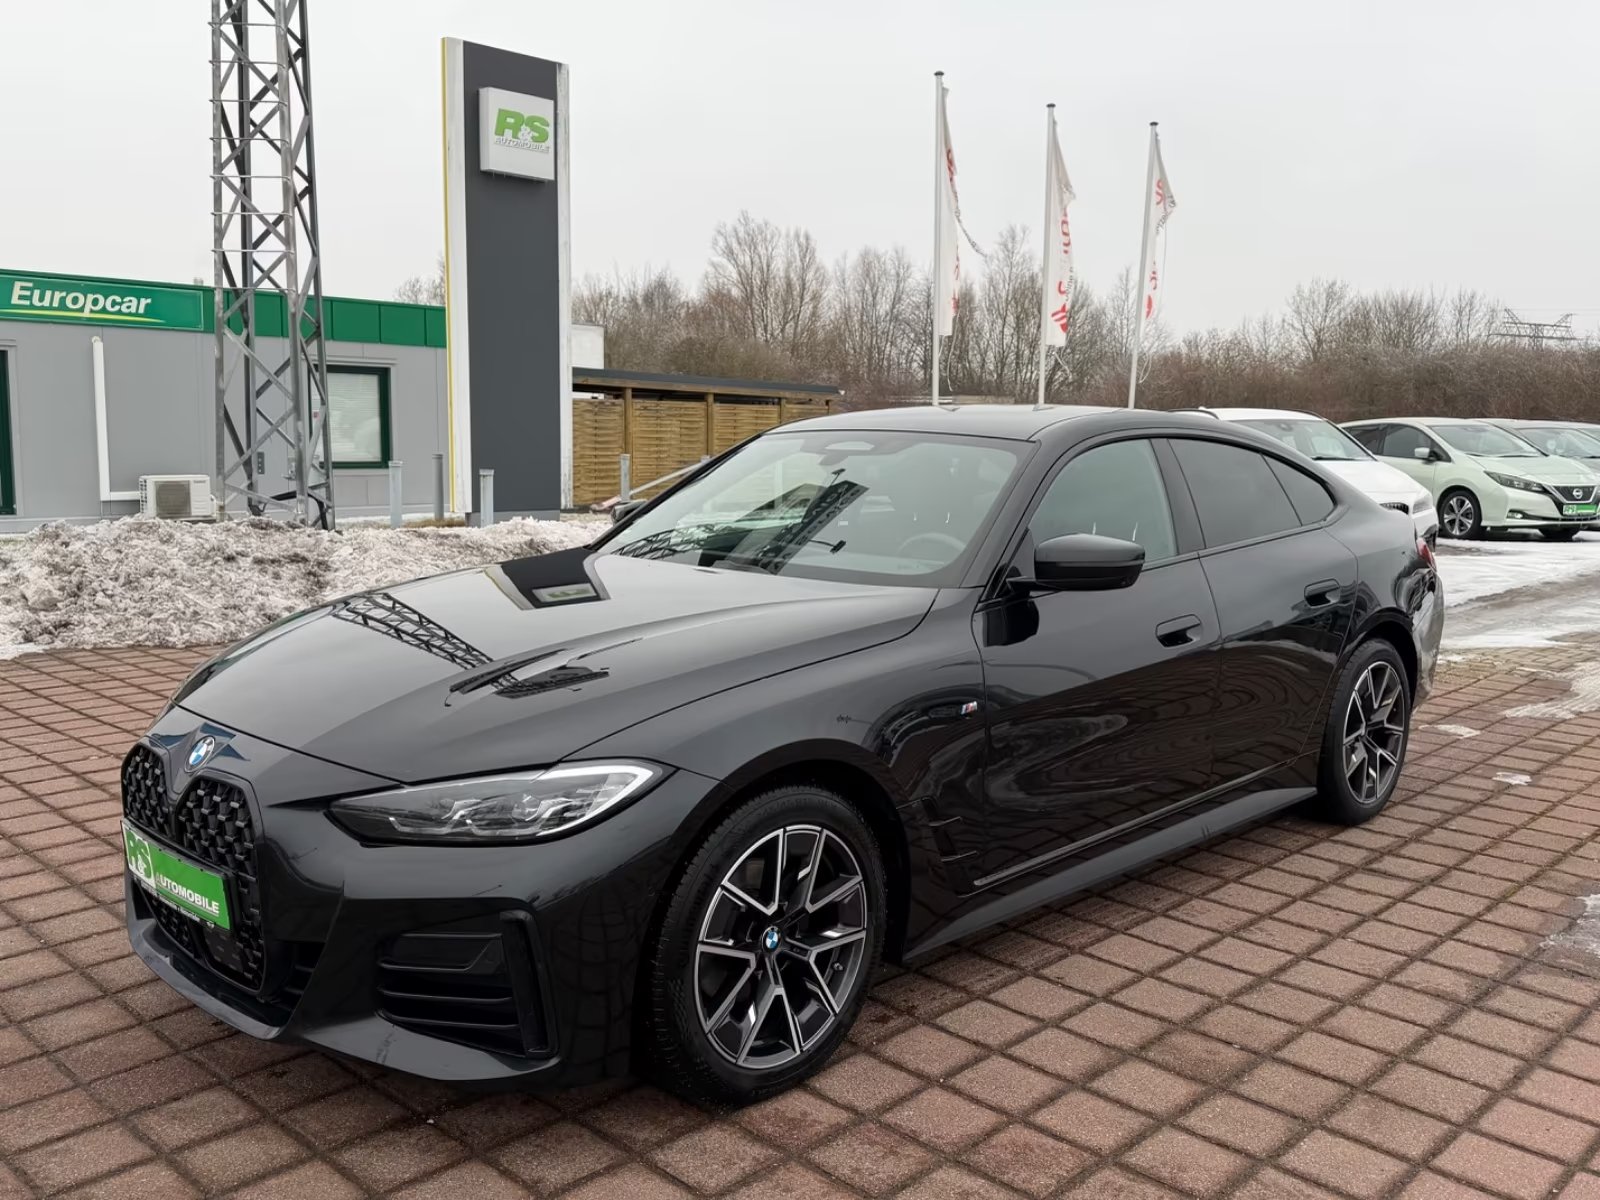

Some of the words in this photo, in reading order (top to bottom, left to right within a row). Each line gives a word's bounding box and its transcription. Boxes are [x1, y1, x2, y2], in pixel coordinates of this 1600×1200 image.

[495, 108, 550, 143] R&S
[11, 280, 152, 315] Europcar
[156, 872, 219, 914] AUTOMOBILE
